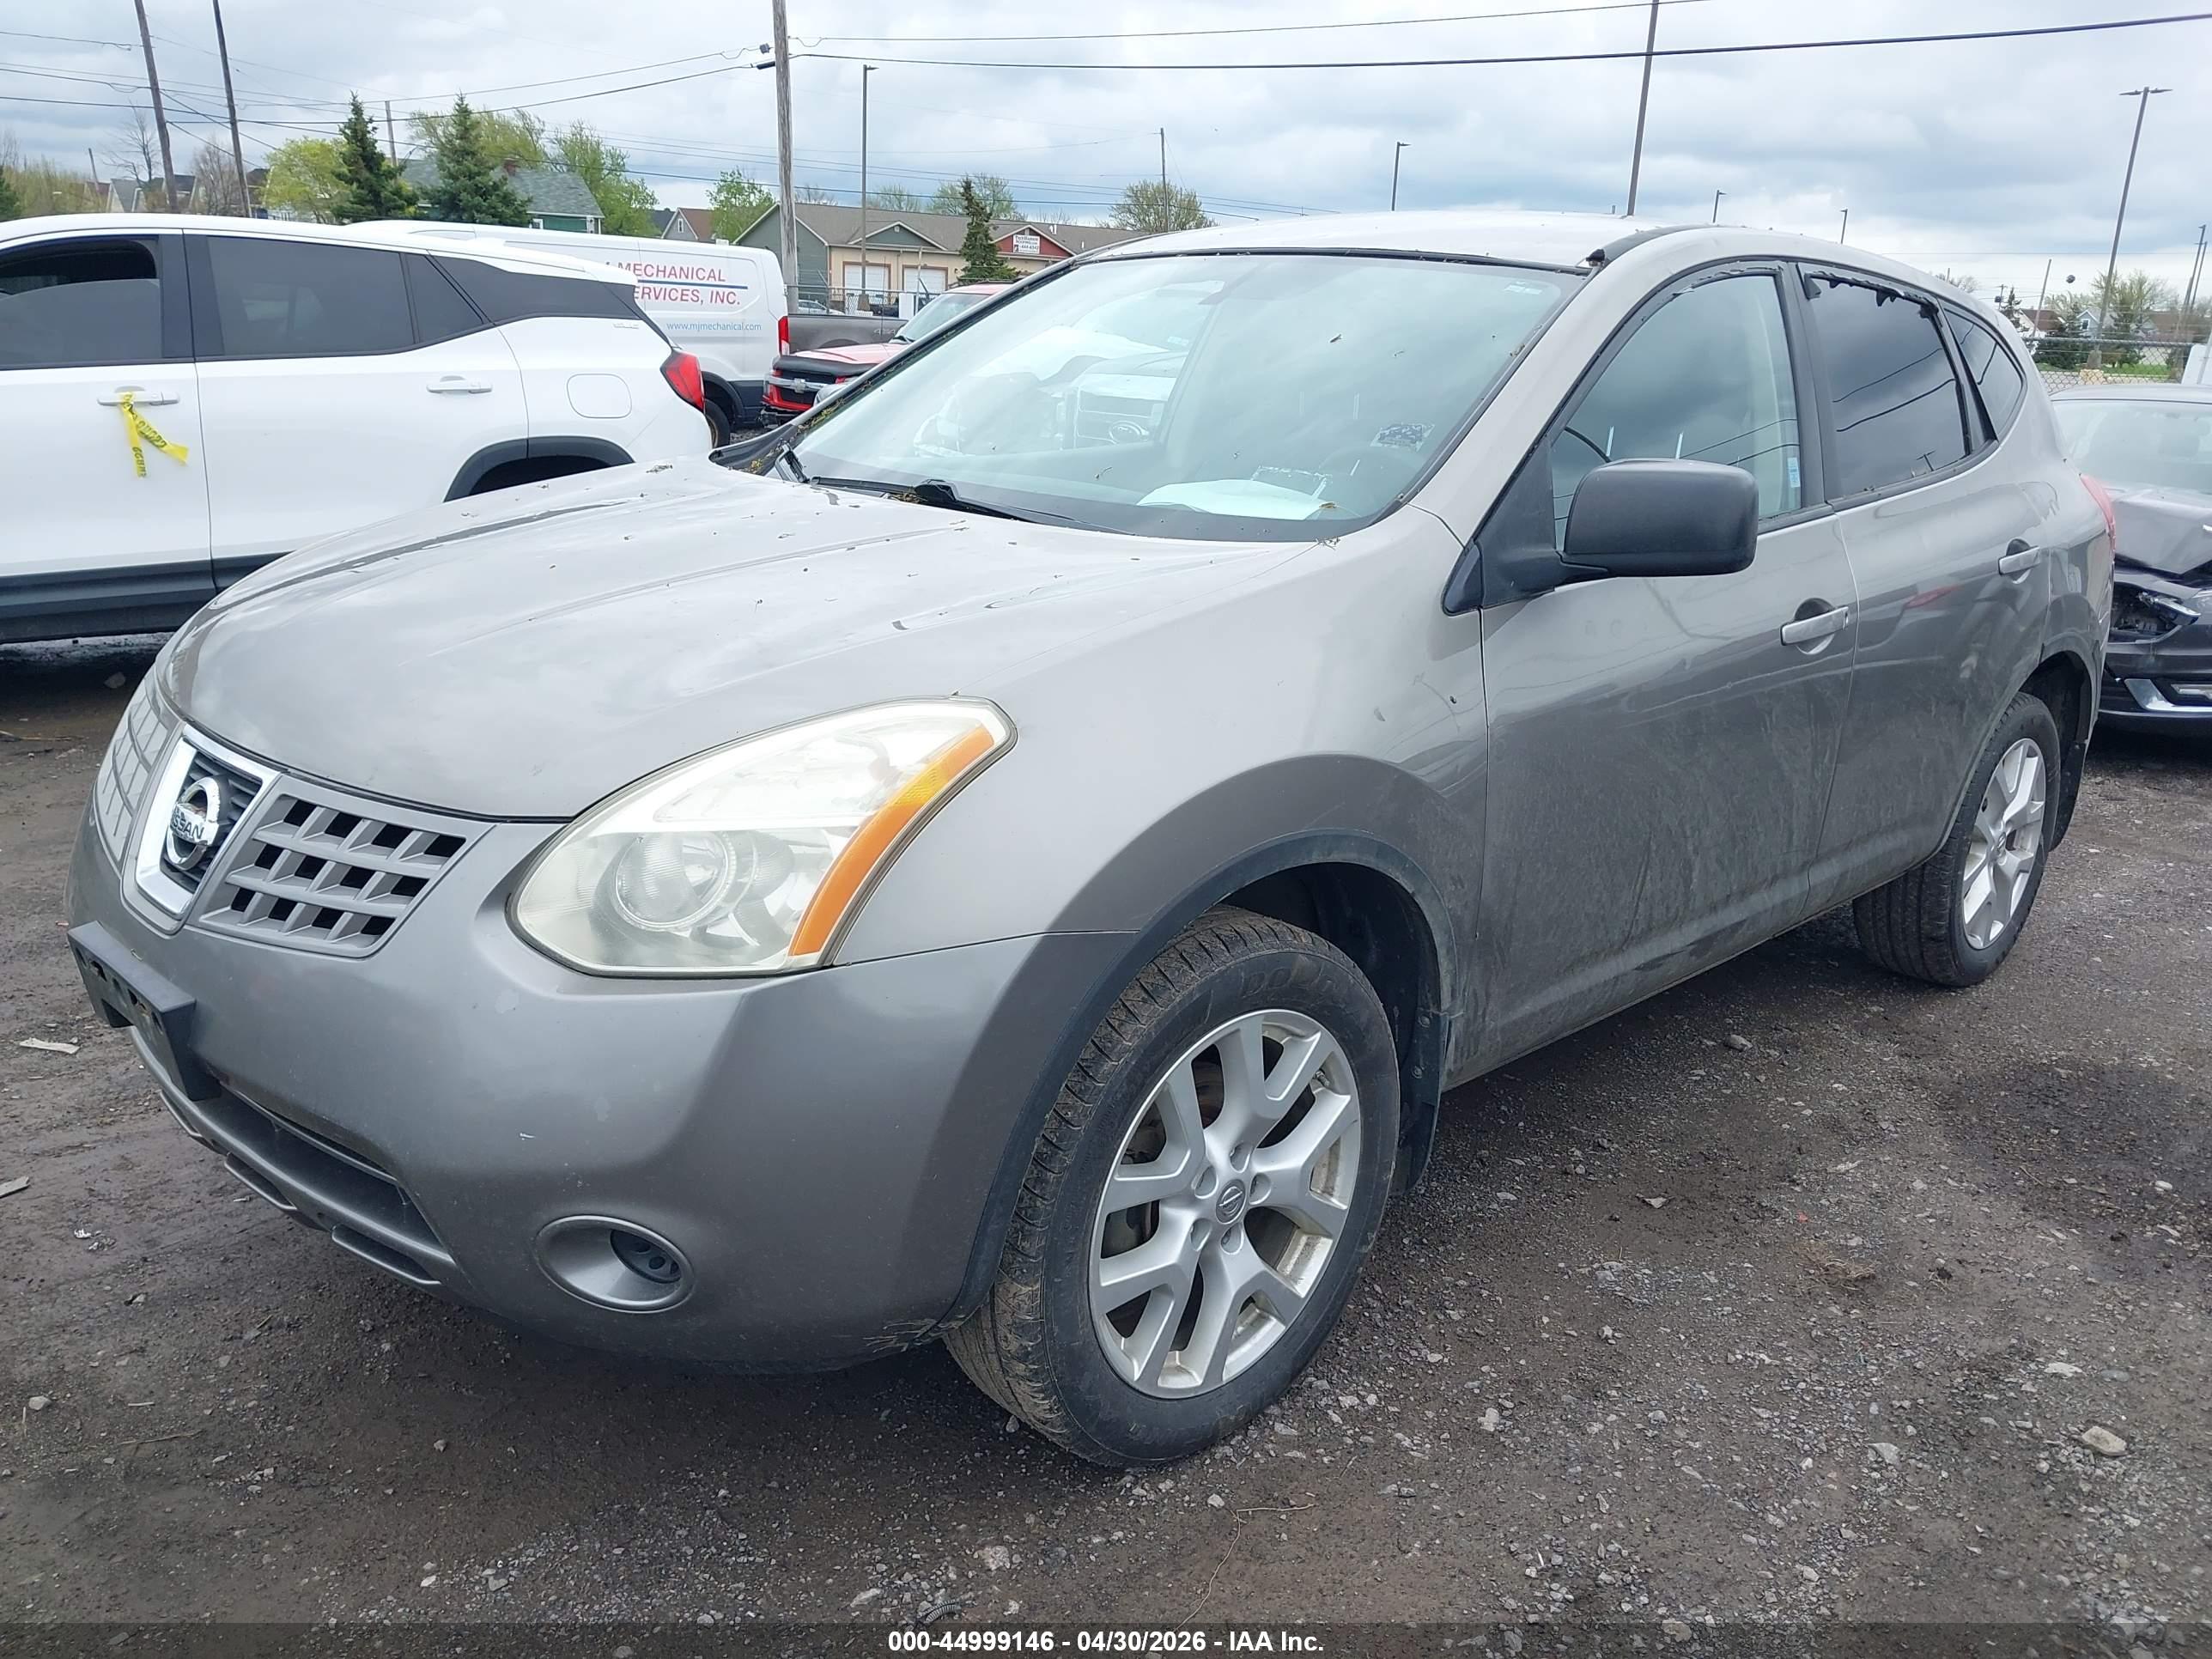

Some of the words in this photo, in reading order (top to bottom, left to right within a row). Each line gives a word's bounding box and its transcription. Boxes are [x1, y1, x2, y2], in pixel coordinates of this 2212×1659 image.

[618, 261, 726, 282] MECHANICAL
[634, 286, 703, 306] ERVICES,
[710, 290, 740, 305] INC.
[666, 321, 762, 332] www.mjmechanical.com
